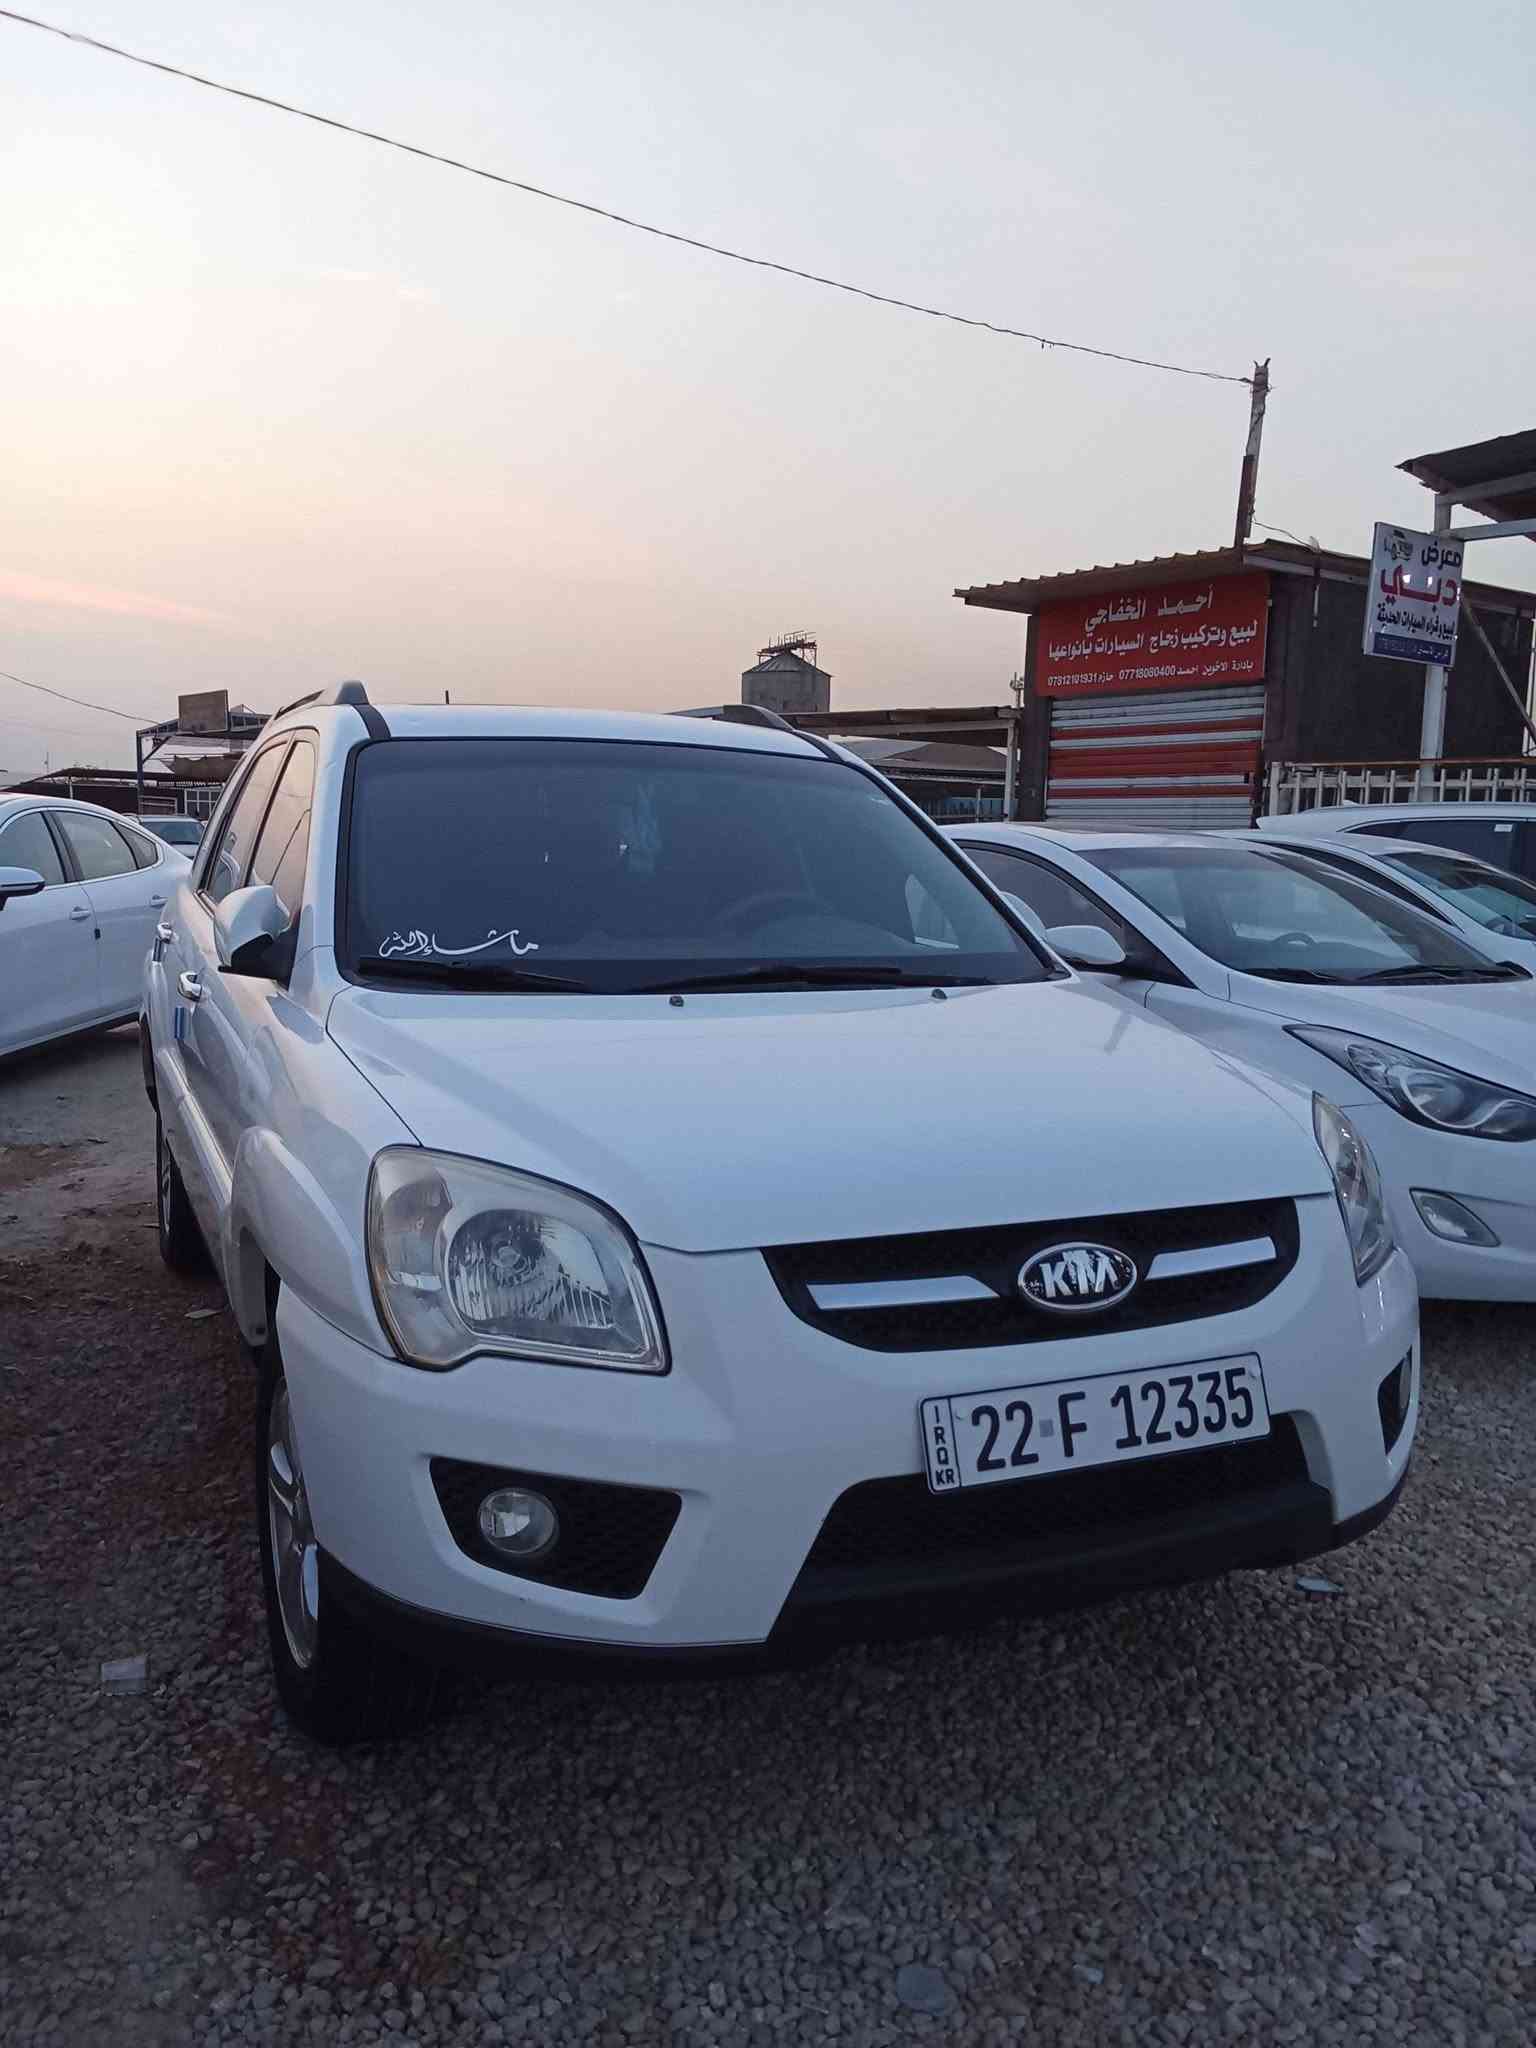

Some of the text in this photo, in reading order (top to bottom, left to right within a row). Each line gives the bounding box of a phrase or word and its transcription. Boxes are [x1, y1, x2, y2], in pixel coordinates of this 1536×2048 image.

[1421, 541, 1462, 570] معرض
[1380, 564, 1458, 612] دبي
[1084, 583, 1213, 636] أحمد الخفاجي
[1096, 632, 1144, 656] السيارات
[1149, 628, 1178, 653] زجاج
[1181, 624, 1226, 649] وتركيب
[1229, 619, 1258, 647] لبيع
[970, 1367, 1255, 1472] 22 F 12335
[935, 1468, 955, 1485] KR
